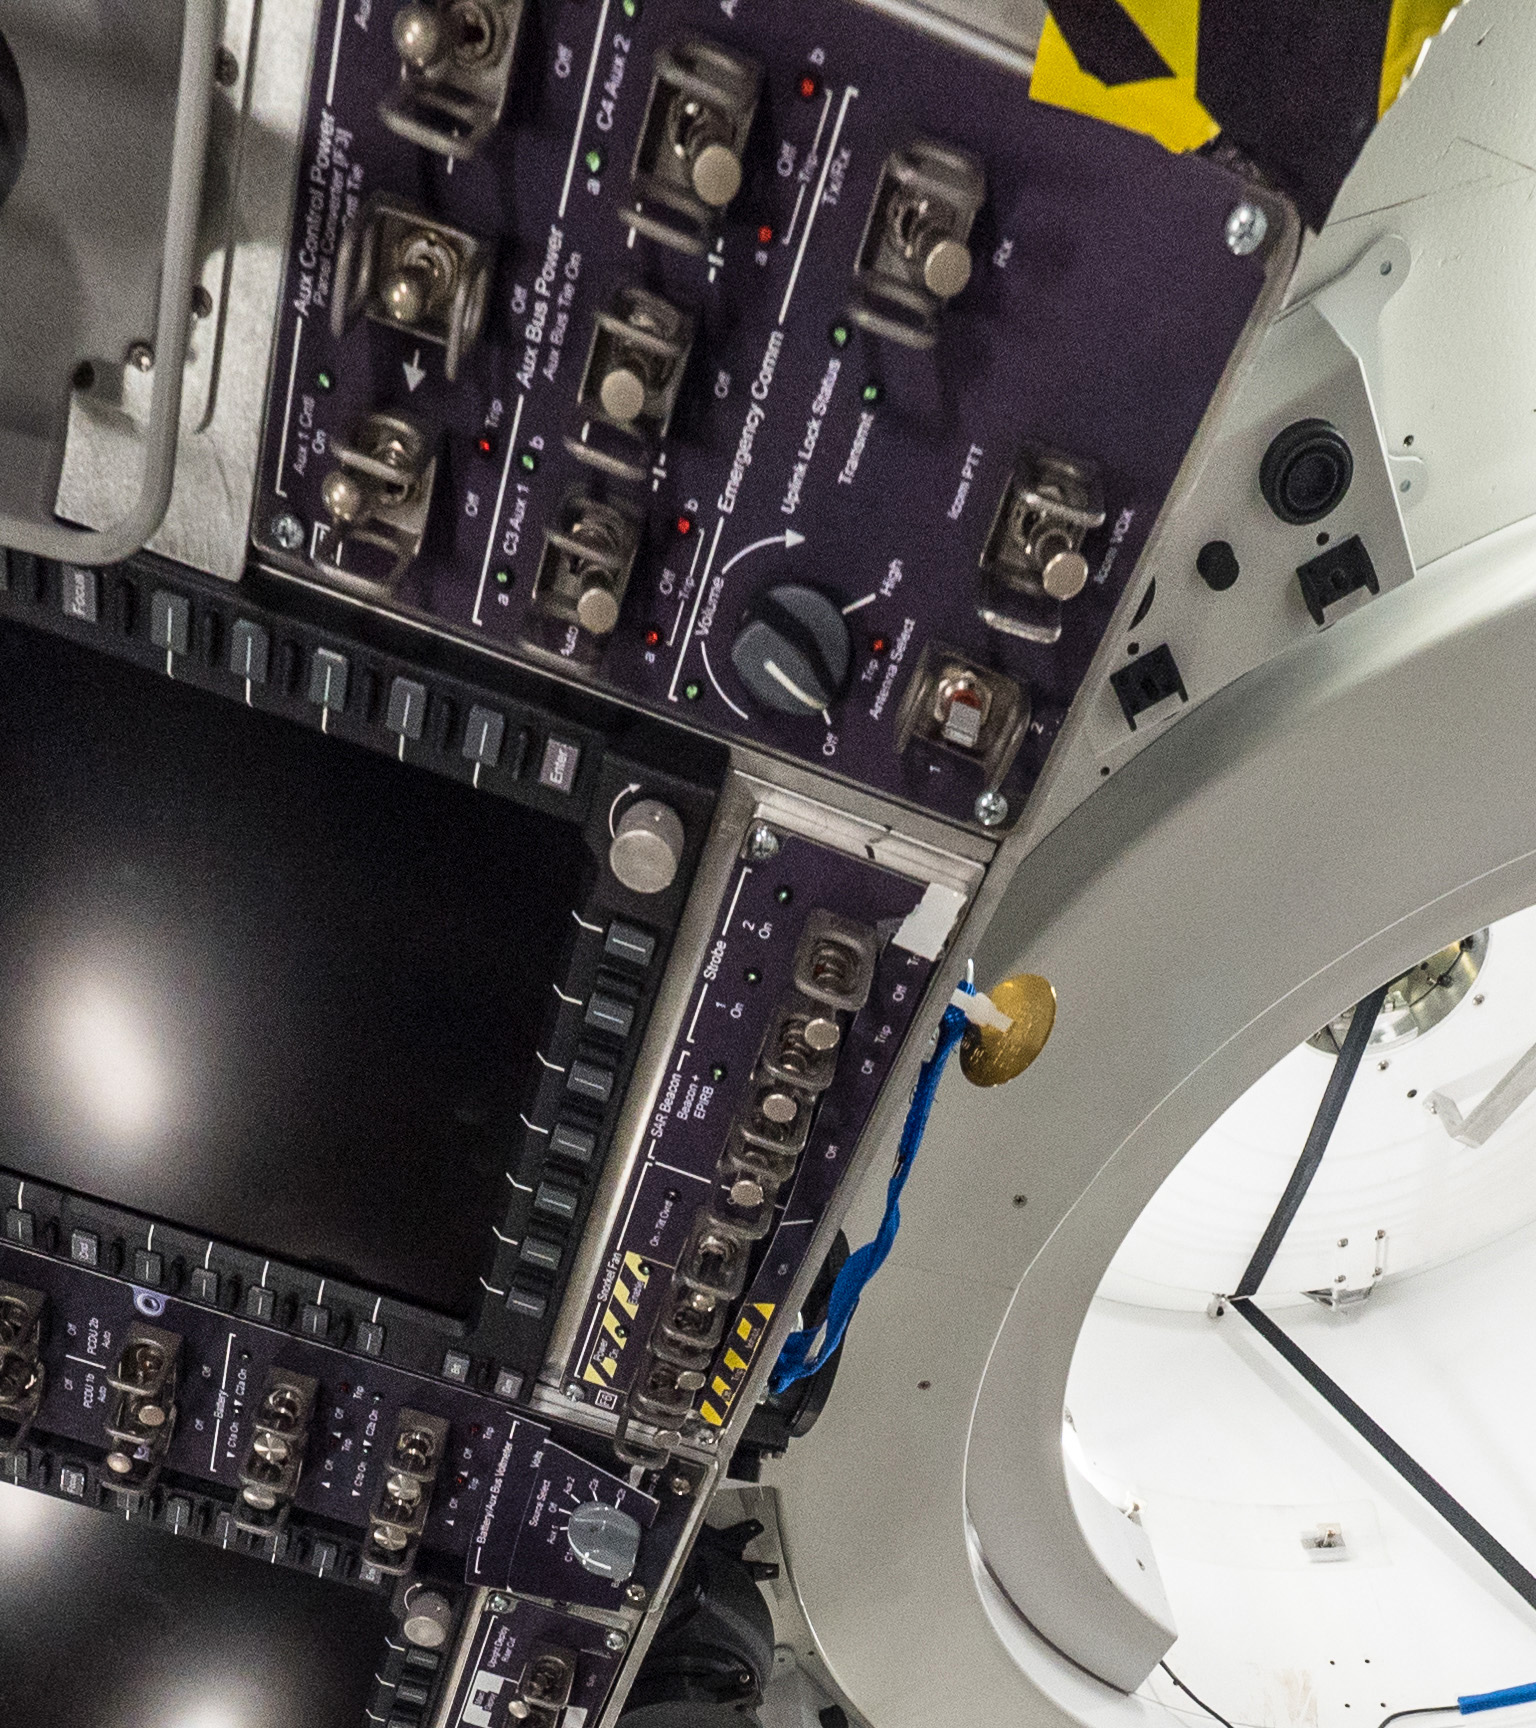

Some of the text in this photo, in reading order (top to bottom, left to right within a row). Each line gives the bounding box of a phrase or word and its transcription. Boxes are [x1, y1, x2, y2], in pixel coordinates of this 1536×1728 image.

[553, 43, 573, 79] Off
[602, 55, 626, 98] Aux
[775, 140, 798, 178] Off
[293, 110, 338, 317] Aux Control Power
[564, 250, 582, 280] On
[509, 283, 528, 314] Off
[515, 223, 565, 388] Aux Bus Power
[549, 312, 568, 345] Bus
[541, 347, 560, 381] Aux
[713, 369, 732, 399] Off
[484, 397, 505, 429] Trip
[715, 329, 785, 513] Emergency Comm
[310, 428, 327, 454] On
[778, 356, 843, 515] Uplink Lock Status
[837, 410, 875, 486] Transmit
[291, 443, 308, 475] Aux
[960, 443, 984, 479] PTT
[464, 490, 481, 517] Off
[506, 494, 528, 531] Aux
[71, 571, 84, 614] Focus
[658, 567, 676, 595] Off
[876, 556, 906, 598] High
[694, 574, 726, 638] Volume
[860, 657, 881, 682] Trip
[867, 616, 917, 720] Antenna Select
[821, 731, 840, 757] Off
[547, 741, 570, 787] Enter
[758, 920, 775, 940] On
[701, 938, 728, 980] Strobe
[728, 1000, 745, 1019] On
[891, 982, 908, 1002] Off
[873, 1023, 893, 1045] Trip
[649, 1071, 683, 1138] SAR Beacon
[676, 1081, 699, 1120] Beacon
[692, 1084, 715, 1120] EPIRB
[595, 1250, 623, 1302] Snorkel Fan
[85, 1328, 98, 1355] PCDU
[83, 1383, 94, 1408] PCDU
[213, 1389, 229, 1419] Battery
[530, 1449, 544, 1469] Volts
[474, 1439, 515, 1545] Battery/Aux Bus Voltmeter
[528, 1478, 552, 1526] Source Select
